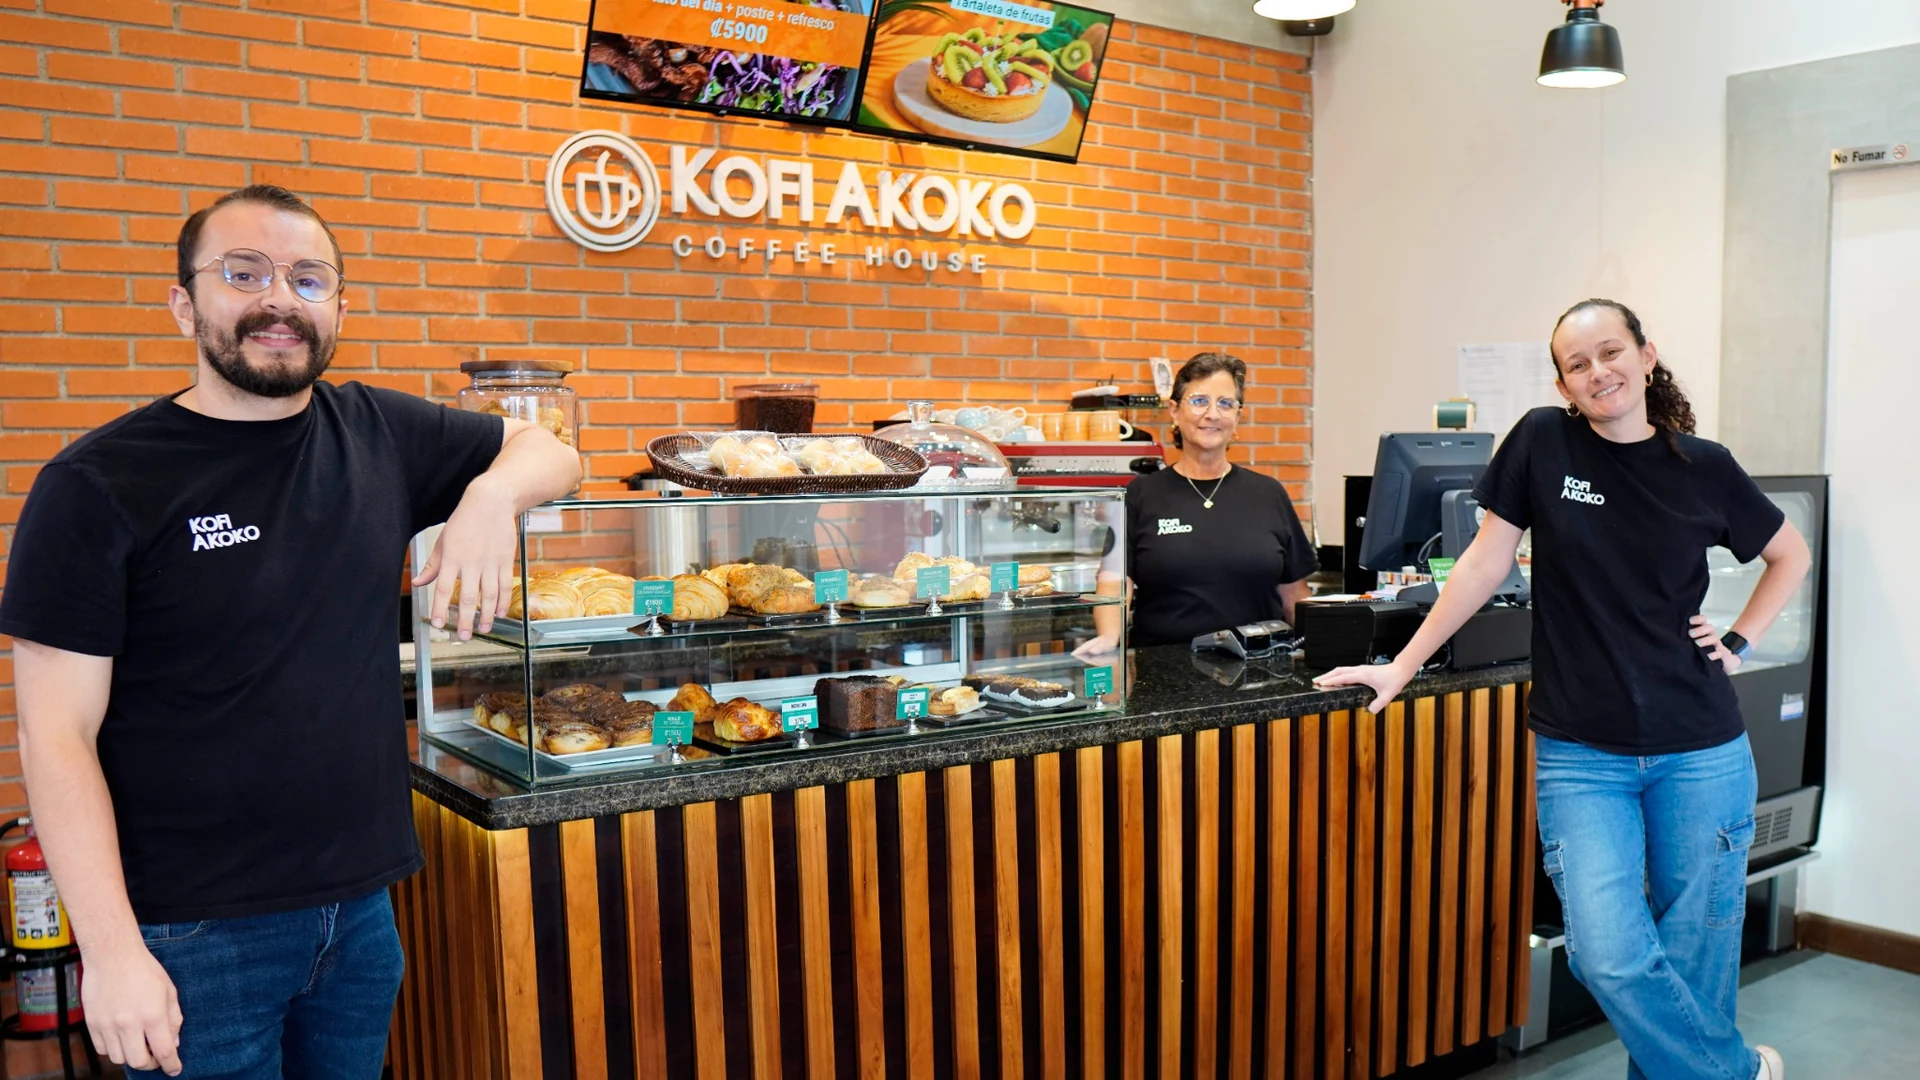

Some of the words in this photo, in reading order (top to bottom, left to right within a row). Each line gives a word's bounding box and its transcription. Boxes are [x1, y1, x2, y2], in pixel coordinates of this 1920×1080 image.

[735, 4, 774, 20] postre
[786, 12, 835, 31] refresco
[1005, 6, 1018, 18] de
[1020, 8, 1051, 25] frutas
[1833, 152, 1848, 164] No
[1852, 150, 1886, 162] Fumar
[670, 145, 814, 222] KOFI
[825, 161, 1037, 240] AKOKO
[672, 234, 837, 265] COFFEE
[865, 245, 987, 274] HOUSE
[1563, 475, 1591, 493] KOFI
[1560, 486, 1605, 506] AKOKO
[188, 513, 233, 534] KOFI
[1157, 524, 1193, 536] AKOKO
[1158, 518, 1180, 528] KOFI
[192, 525, 261, 552] AKOKO
